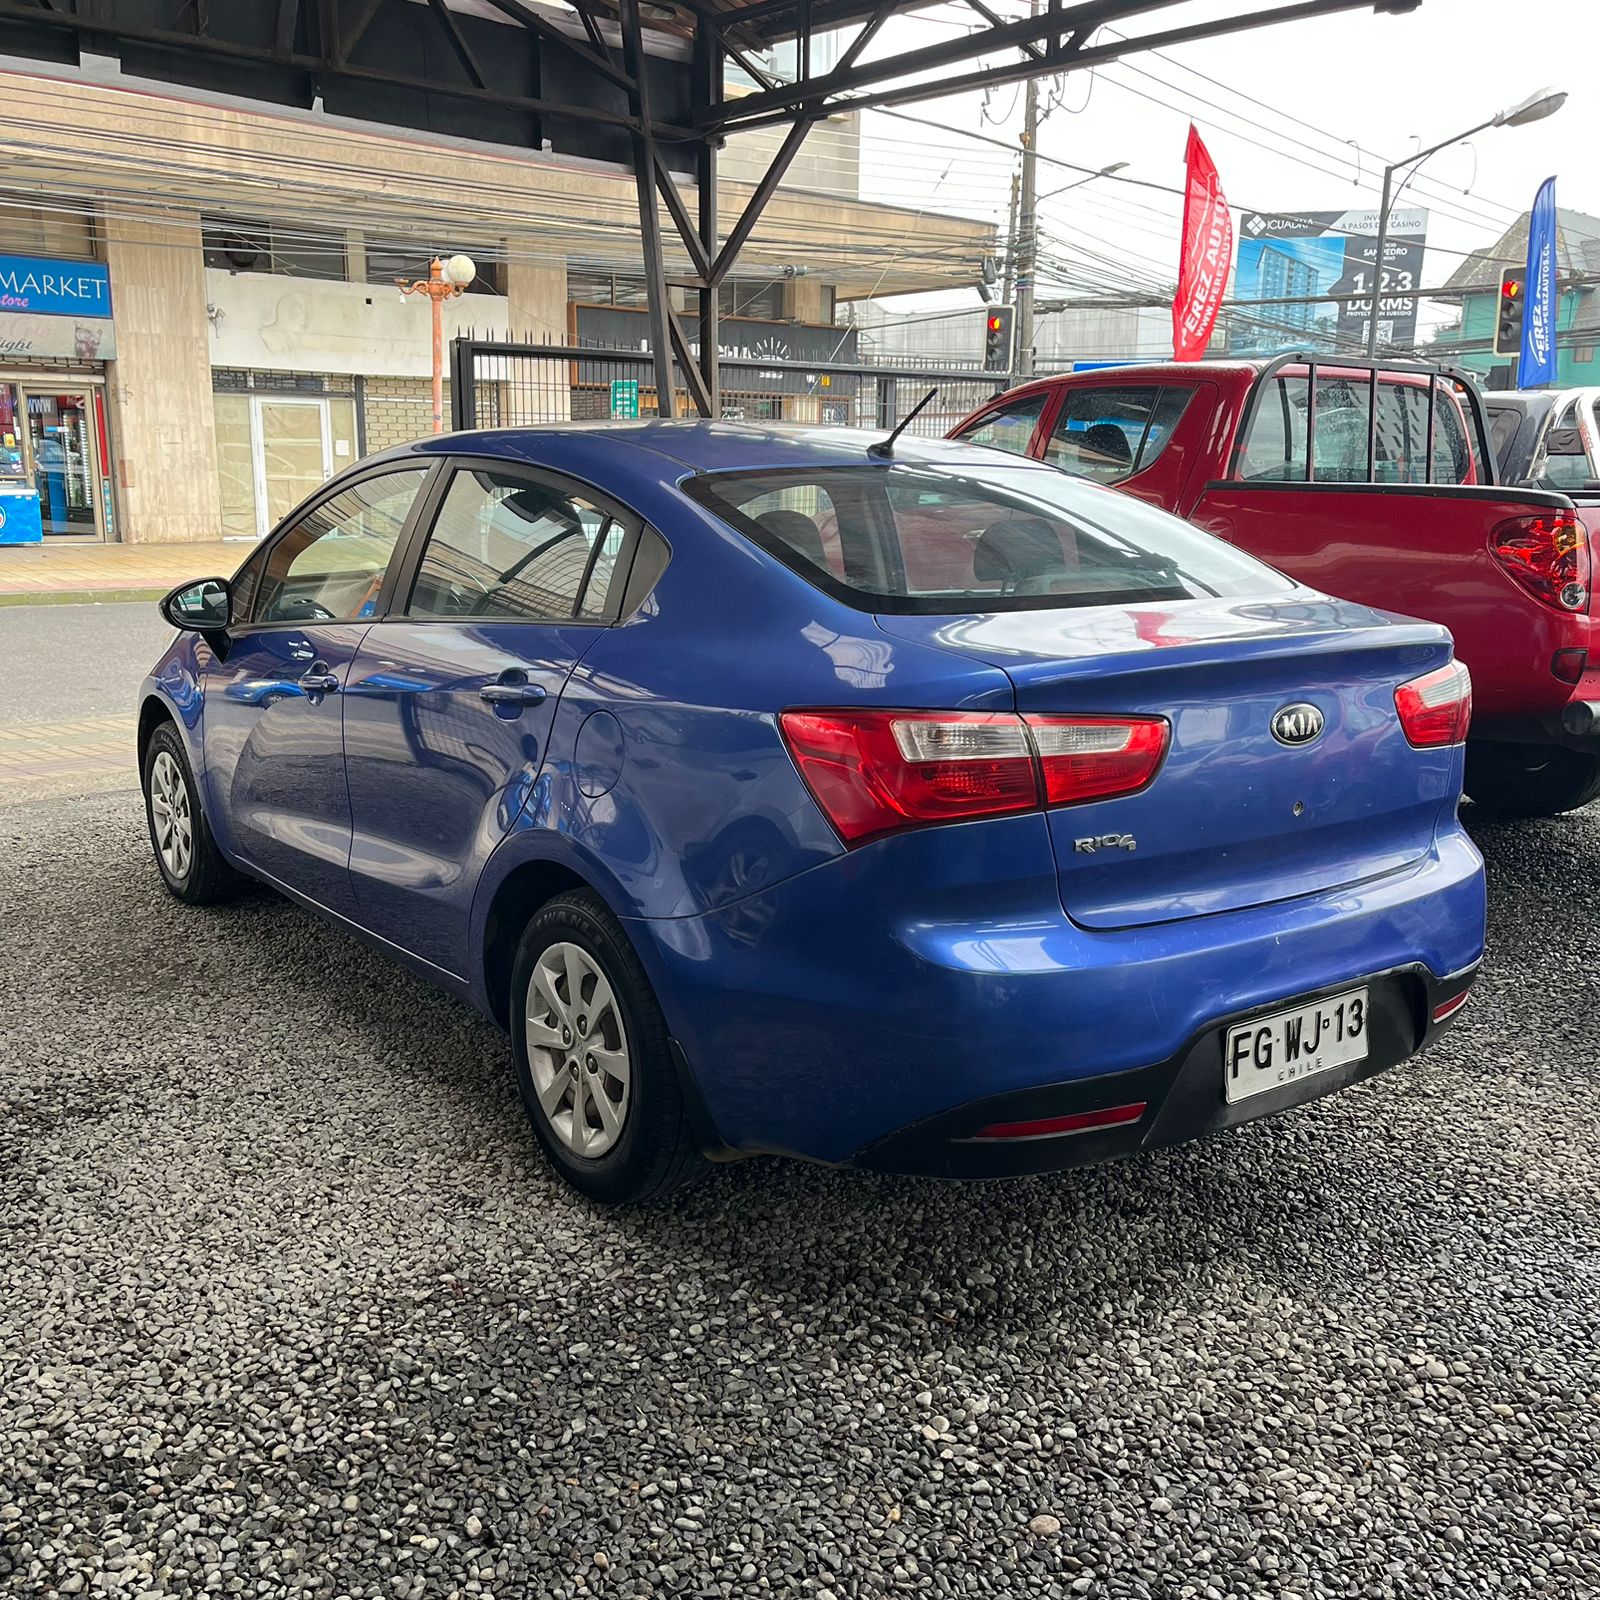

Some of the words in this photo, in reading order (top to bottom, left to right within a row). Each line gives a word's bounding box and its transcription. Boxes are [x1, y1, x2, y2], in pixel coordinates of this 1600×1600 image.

[1391, 220, 1421, 228] CASINO
[0, 271, 107, 299] MARKET
[0, 293, 30, 308] tore
[0, 337, 33, 352] ight
[1532, 303, 1547, 366] PEREZ
[1281, 713, 1318, 738] KIA
[1278, 1055, 1323, 1081] CHILE
